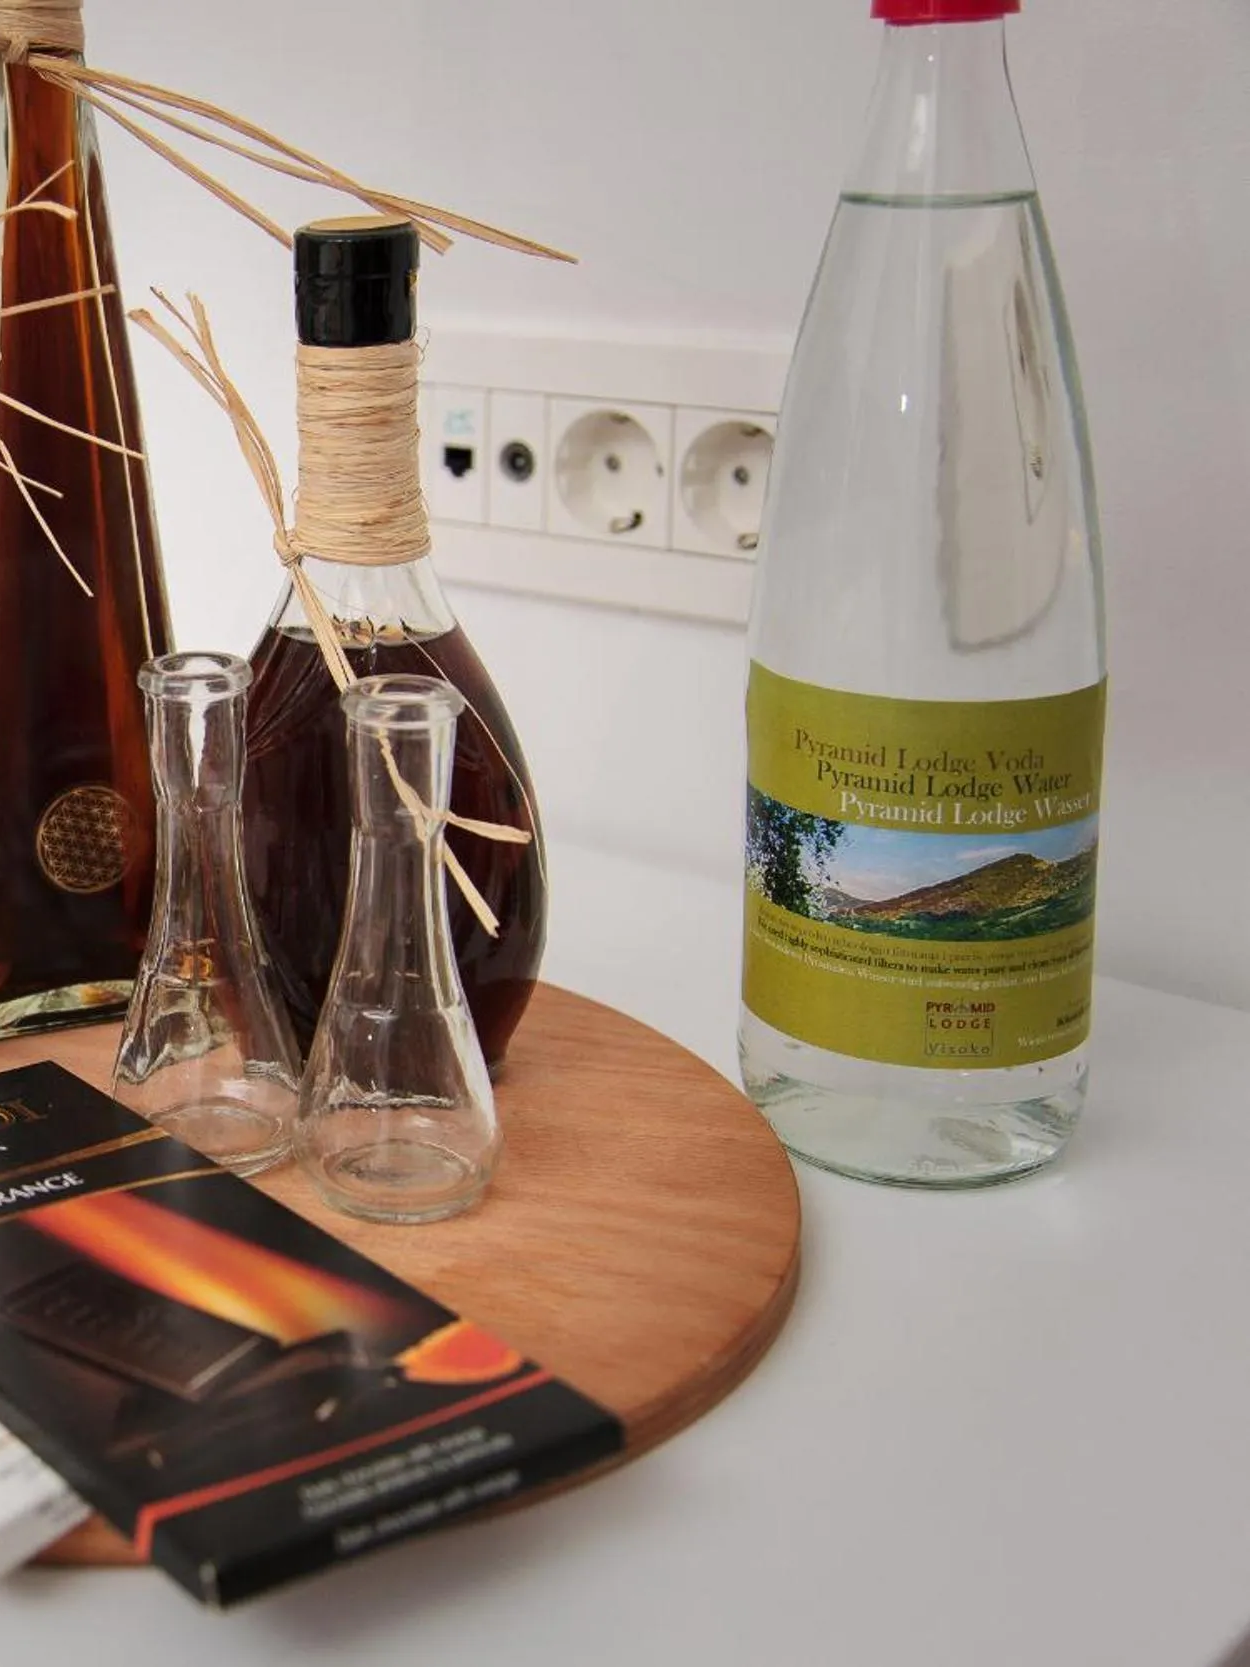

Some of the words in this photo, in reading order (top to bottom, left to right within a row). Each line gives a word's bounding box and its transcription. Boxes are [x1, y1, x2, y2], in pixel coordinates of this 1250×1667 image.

[795, 728, 886, 768] Pyramid
[898, 748, 976, 775] Lodge
[986, 748, 1044, 771] Voda
[817, 759, 914, 796] Pyramid
[927, 774, 1002, 801] Lodge
[1013, 772, 1072, 795] Water
[840, 790, 943, 825] Pyramid
[953, 802, 1028, 829] Lodge
[1034, 792, 1091, 820] Wasser
[874, 957, 904, 971] filters
[906, 963, 918, 973] to
[921, 963, 950, 975] make
[929, 1018, 991, 1030] LODGE
